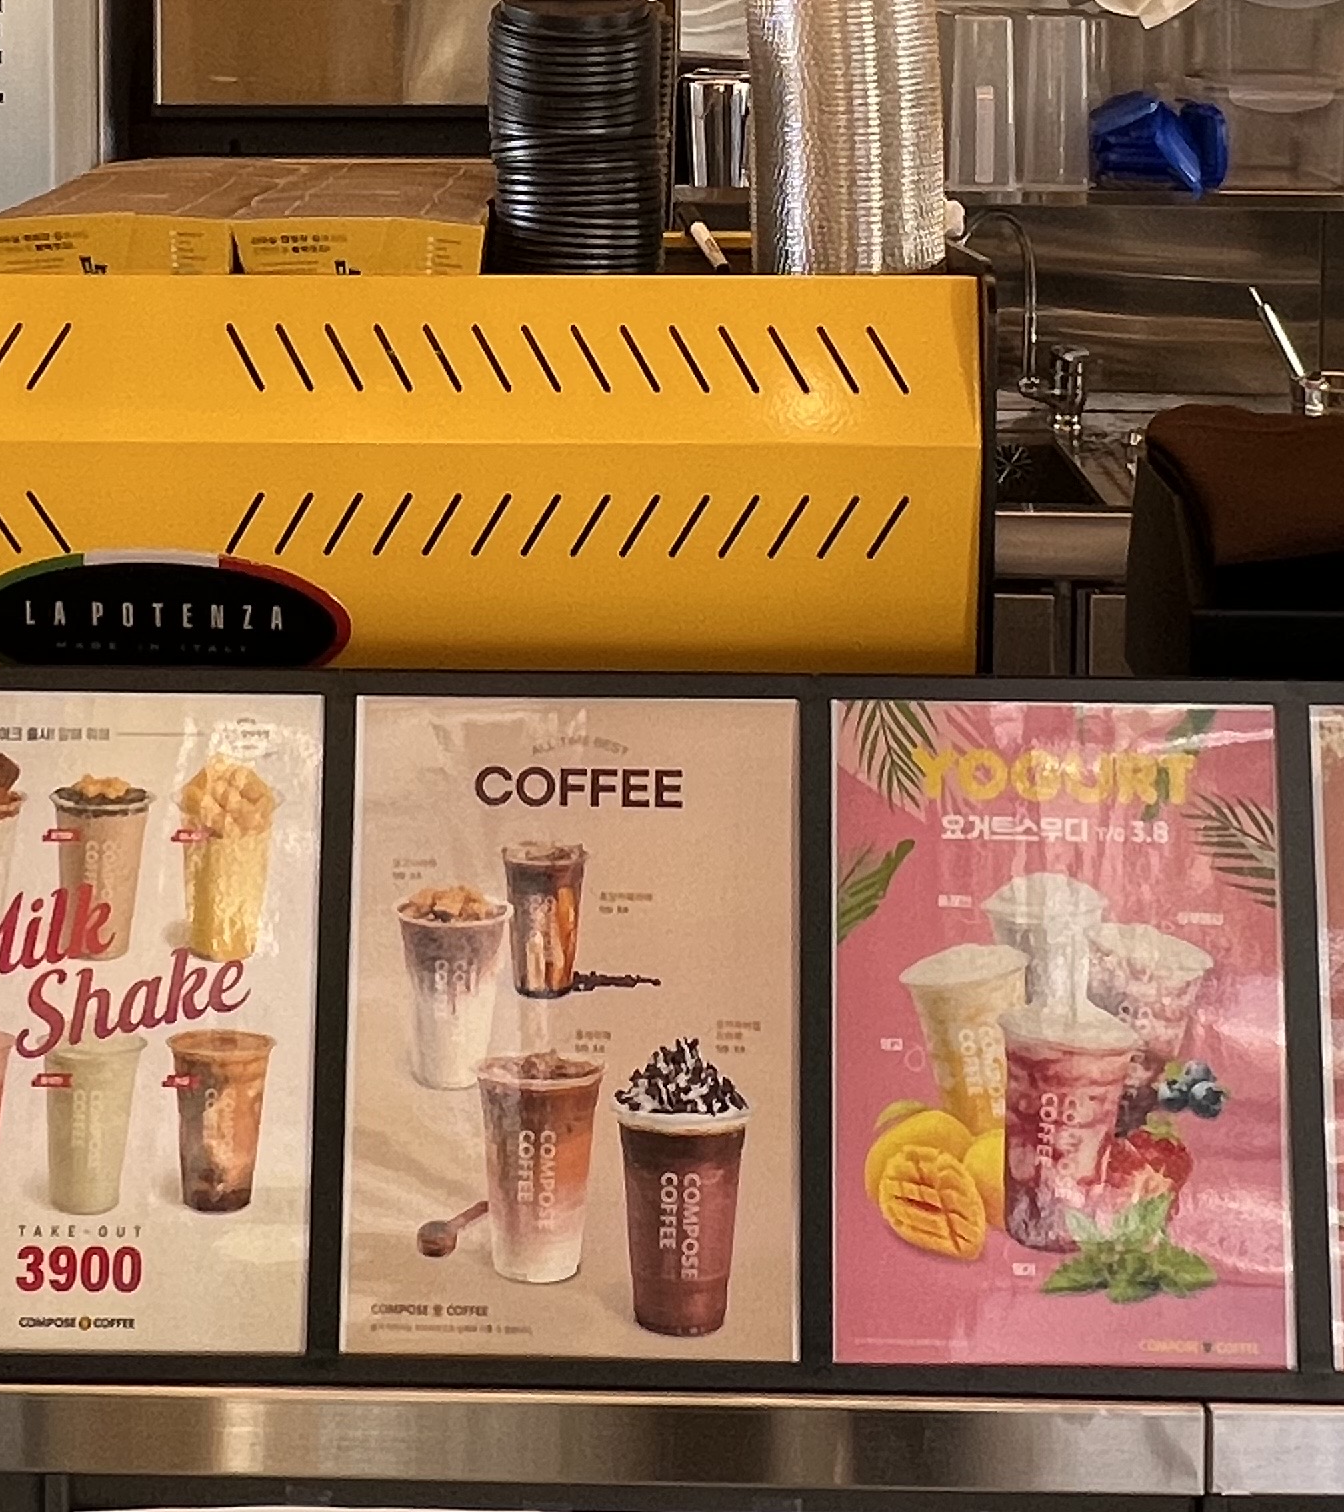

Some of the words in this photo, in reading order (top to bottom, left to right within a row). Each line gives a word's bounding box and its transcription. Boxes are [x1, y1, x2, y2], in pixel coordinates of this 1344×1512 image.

[474, 766, 684, 810] COFFEE
[911, 748, 1197, 805] YOGURT
[940, 814, 1089, 843] 요거트스무디
[1130, 819, 1170, 845] 3.8
[16, 947, 251, 1059] Shake
[1036, 1092, 1058, 1168] COFFEE
[516, 1129, 536, 1203] COFFEE
[18, 1224, 143, 1239] TAKE-OUT
[659, 1171, 679, 1250] COFFEE
[680, 1172, 701, 1279] COMPOSE
[16, 1245, 143, 1293] 3900
[18, 1316, 76, 1330] COMPOSE
[92, 1316, 136, 1330] COFFEE
[370, 1303, 429, 1318] COMPOSE
[446, 1304, 490, 1318] COFFEE
